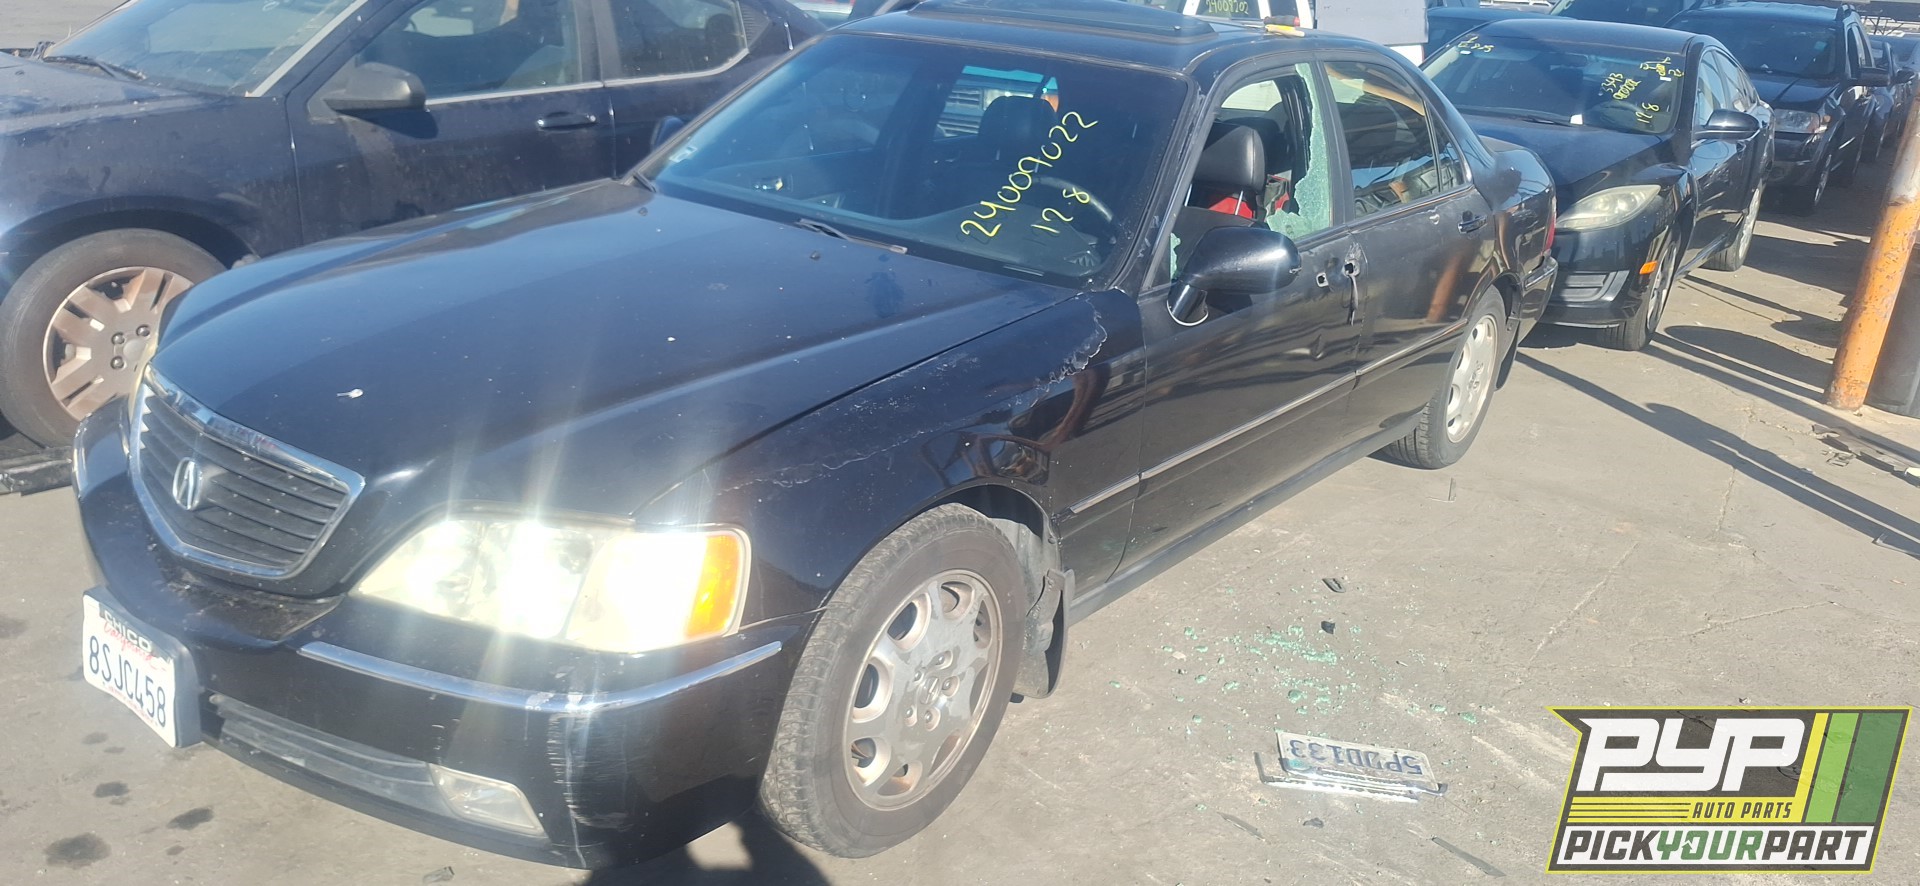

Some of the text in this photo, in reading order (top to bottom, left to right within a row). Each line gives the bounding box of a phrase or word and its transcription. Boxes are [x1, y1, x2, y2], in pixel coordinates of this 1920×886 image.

[960, 111, 1098, 237] 24009022
[103, 609, 153, 653] CHICO
[89, 635, 166, 728] 8SJC458
